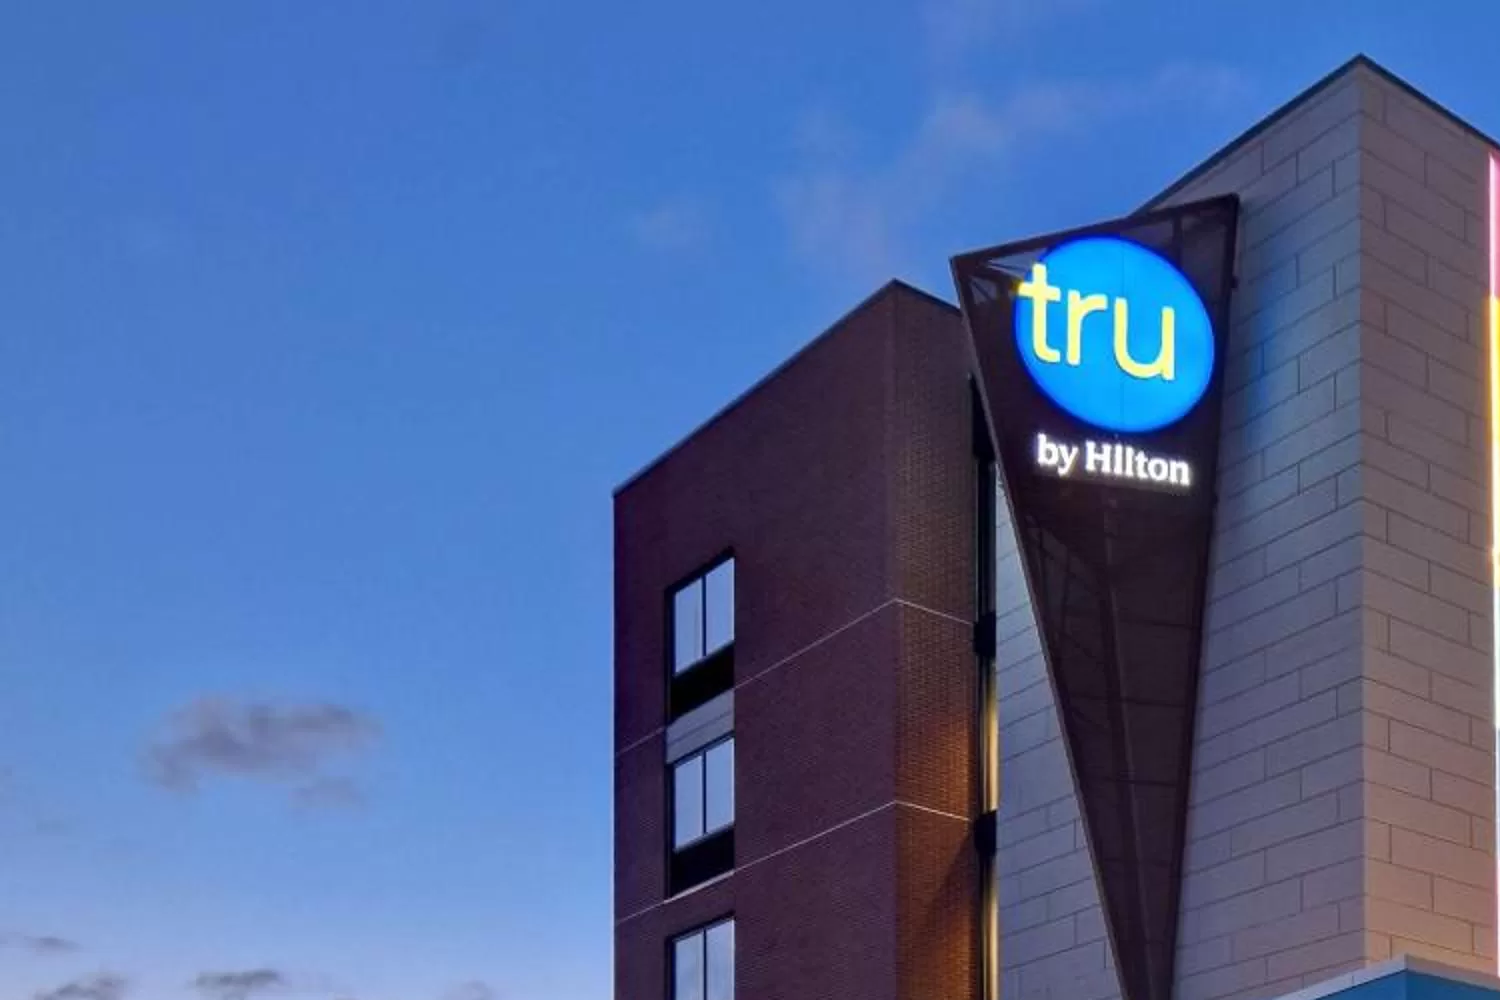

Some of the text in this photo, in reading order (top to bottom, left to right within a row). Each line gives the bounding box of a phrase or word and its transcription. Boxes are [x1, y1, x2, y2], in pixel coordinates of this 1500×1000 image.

[1016, 262, 1176, 381] tru
[1036, 433, 1191, 486] by Hilton
